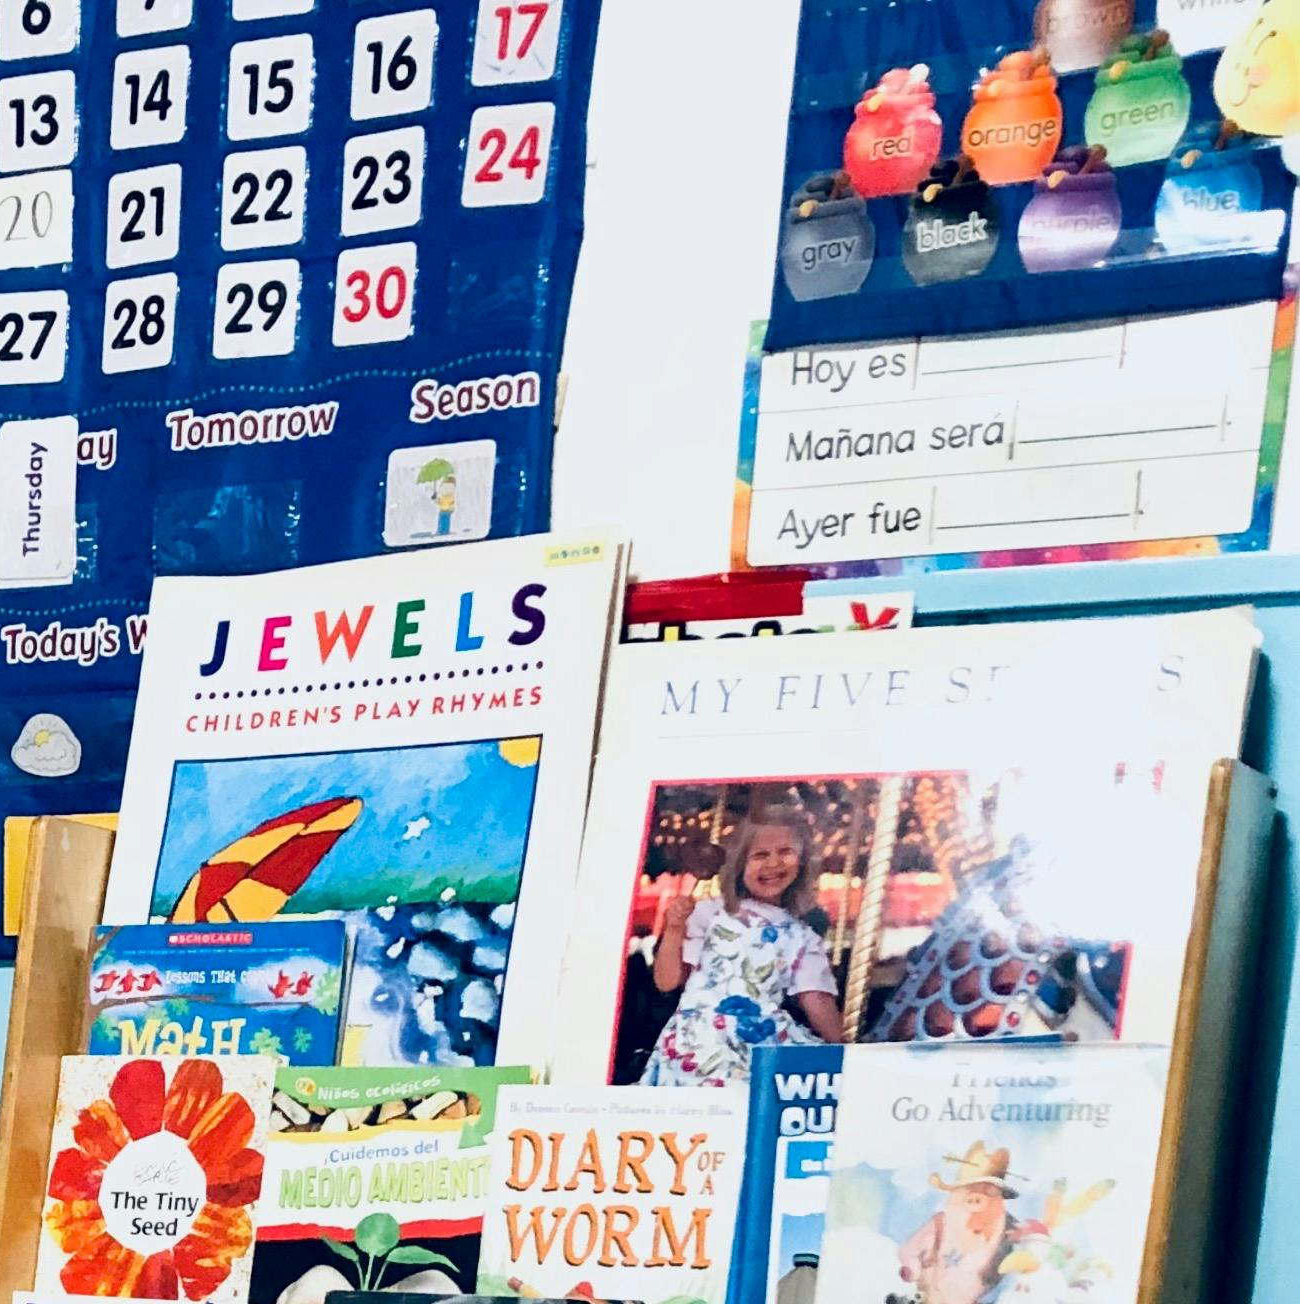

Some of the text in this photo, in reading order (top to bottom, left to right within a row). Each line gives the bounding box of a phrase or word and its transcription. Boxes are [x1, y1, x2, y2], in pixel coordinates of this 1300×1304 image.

[22, 0, 51, 35] 6
[8, 94, 59, 147] 13
[124, 70, 173, 125] 14
[243, 59, 294, 115] 15
[366, 35, 418, 94] 16
[493, 2, 549, 60] 17
[968, 119, 1056, 150] orange
[1099, 100, 1175, 138] green
[872, 131, 910, 158] red
[119, 186, 167, 242] 21
[230, 168, 293, 225] 22
[351, 152, 412, 210] 23
[474, 127, 541, 183] 24
[1182, 187, 1237, 212] blue
[917, 212, 988, 253] black
[801, 236, 856, 272] gray
[112, 294, 165, 350] 28
[224, 280, 288, 335] 29
[342, 267, 407, 323] 30
[790, 351, 906, 392] Hoy es
[414, 376, 539, 421] Season
[171, 403, 338, 449] Tomorrow
[786, 413, 1005, 462] Mañana será
[23, 441, 44, 556] Thursday
[778, 501, 921, 549] Ayer fue
[4, 624, 117, 663] Today's
[200, 584, 547, 677] JEWELS
[185, 685, 543, 734] CHILDREN'S PLAY RHYMES
[659, 679, 743, 716] MY
[775, 669, 911, 711] FIVE
[177, 934, 251, 944] SCHOLASTIC
[318, 1088, 360, 1100] Niños
[892, 1095, 1111, 1128] Go Adventuring
[414, 1140, 438, 1154] del
[505, 1128, 708, 1196] DIARY
[697, 1151, 726, 1172] OF
[111, 1192, 199, 1217] The Tiny
[279, 1166, 362, 1209] MEDIO
[699, 1175, 714, 1196] A
[130, 1218, 178, 1236] Seed
[503, 1203, 712, 1269] WORM
